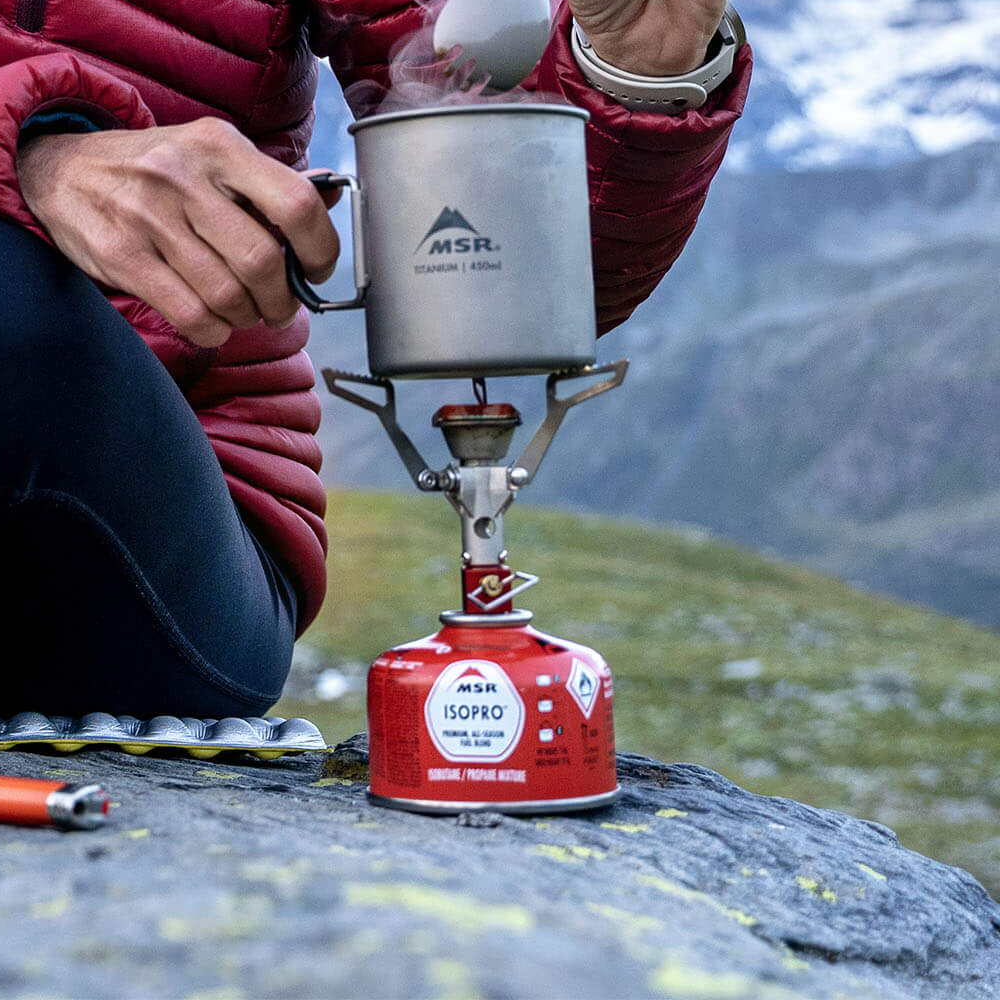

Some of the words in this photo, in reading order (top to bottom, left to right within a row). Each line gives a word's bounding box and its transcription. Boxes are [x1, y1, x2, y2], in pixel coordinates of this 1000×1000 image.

[429, 238, 492, 255] MSR
[457, 683, 497, 693] MSR
[444, 704, 503, 720] ISOPRO
